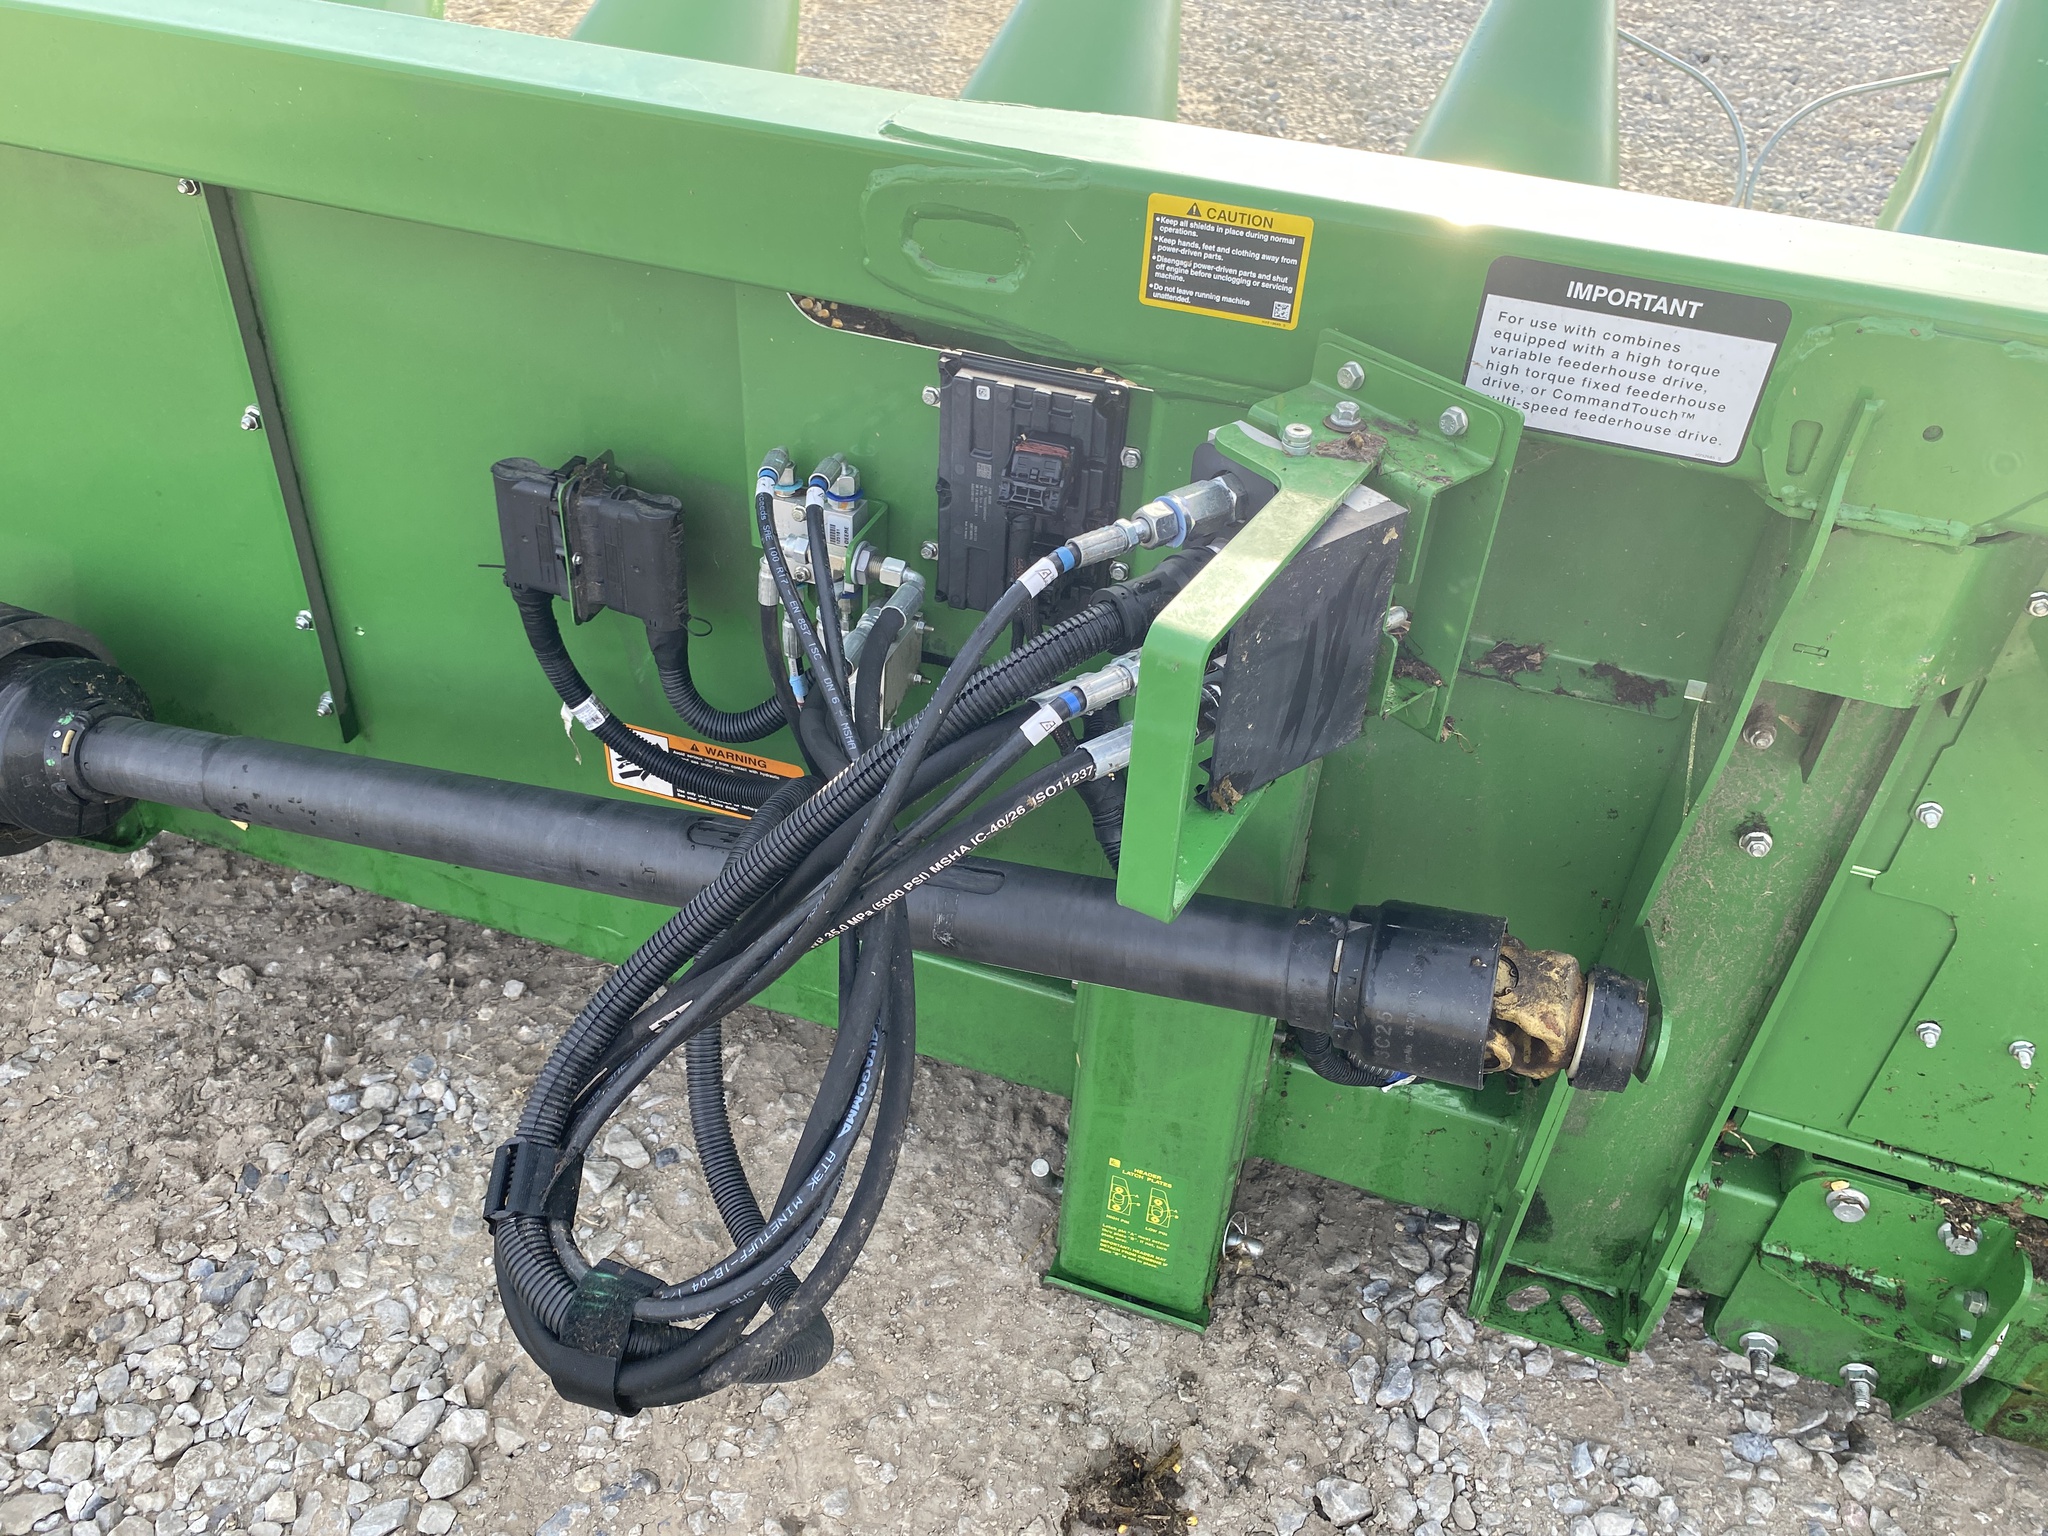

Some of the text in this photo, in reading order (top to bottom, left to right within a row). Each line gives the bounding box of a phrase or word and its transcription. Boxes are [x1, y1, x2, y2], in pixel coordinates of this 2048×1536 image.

[1159, 226, 1198, 237] operations.
[1161, 216, 1295, 245] Keep all shields in place during normal
[1207, 208, 1273, 229] CAUTION
[1157, 245, 1223, 261] power-driven parts.
[1159, 236, 1176, 246] Keep
[1177, 239, 1201, 250] hands,
[1202, 243, 1215, 251] feet
[1231, 248, 1260, 260] clothing
[1261, 254, 1279, 263] away
[1281, 256, 1297, 265] from
[1155, 272, 1185, 282] machine.
[1157, 255, 1192, 268] Disengage
[1193, 262, 1237, 275] power-driven
[1238, 270, 1256, 278] parts
[1272, 275, 1288, 283] shut
[1166, 266, 1189, 274] engine
[1190, 269, 1212, 278] before
[1213, 274, 1251, 287] unclogging
[1261, 282, 1293, 294] servicing
[1153, 292, 1191, 303] unattended.
[1154, 283, 1163, 291] Do
[1176, 287, 1194, 297] leave
[1195, 291, 1221, 302] running
[1222, 296, 1250, 306] machine
[1567, 281, 1703, 318] IMPORTANT
[1498, 311, 1680, 353] For use with combines
[1494, 330, 1720, 377] equipped with a high torque
[1491, 346, 1706, 393] variable feederhouse drive,
[1482, 376, 1523, 393] drive,
[1531, 387, 1546, 396] or
[1486, 360, 1726, 412] high torque fixed feederhouse
[1487, 395, 1721, 445] lti-speed feederhouse drive.
[762, 524, 773, 542] SAE
[768, 546, 780, 563] 100
[776, 566, 789, 584] R17
[789, 600, 801, 614] EN
[797, 618, 812, 636] 857
[823, 677, 836, 692] DN
[831, 695, 840, 705] 6
[840, 721, 857, 751] MSHA
[704, 745, 767, 769] WARNING
[824, 924, 849, 939] 35.0
[846, 911, 875, 926] MPa
[872, 889, 905, 911] (5000
[903, 871, 931, 891] PSI)
[929, 844, 971, 874] MSHA
[970, 805, 1026, 846] IC-40/26
[1032, 764, 1094, 806] ISO11237
[806, 1150, 837, 1192] AT3K
[1122, 1170, 1172, 1188] LATCH PLATES
[1134, 1169, 1161, 1180] HEADER
[691, 1196, 804, 1293] MINETUFF-1B-04
